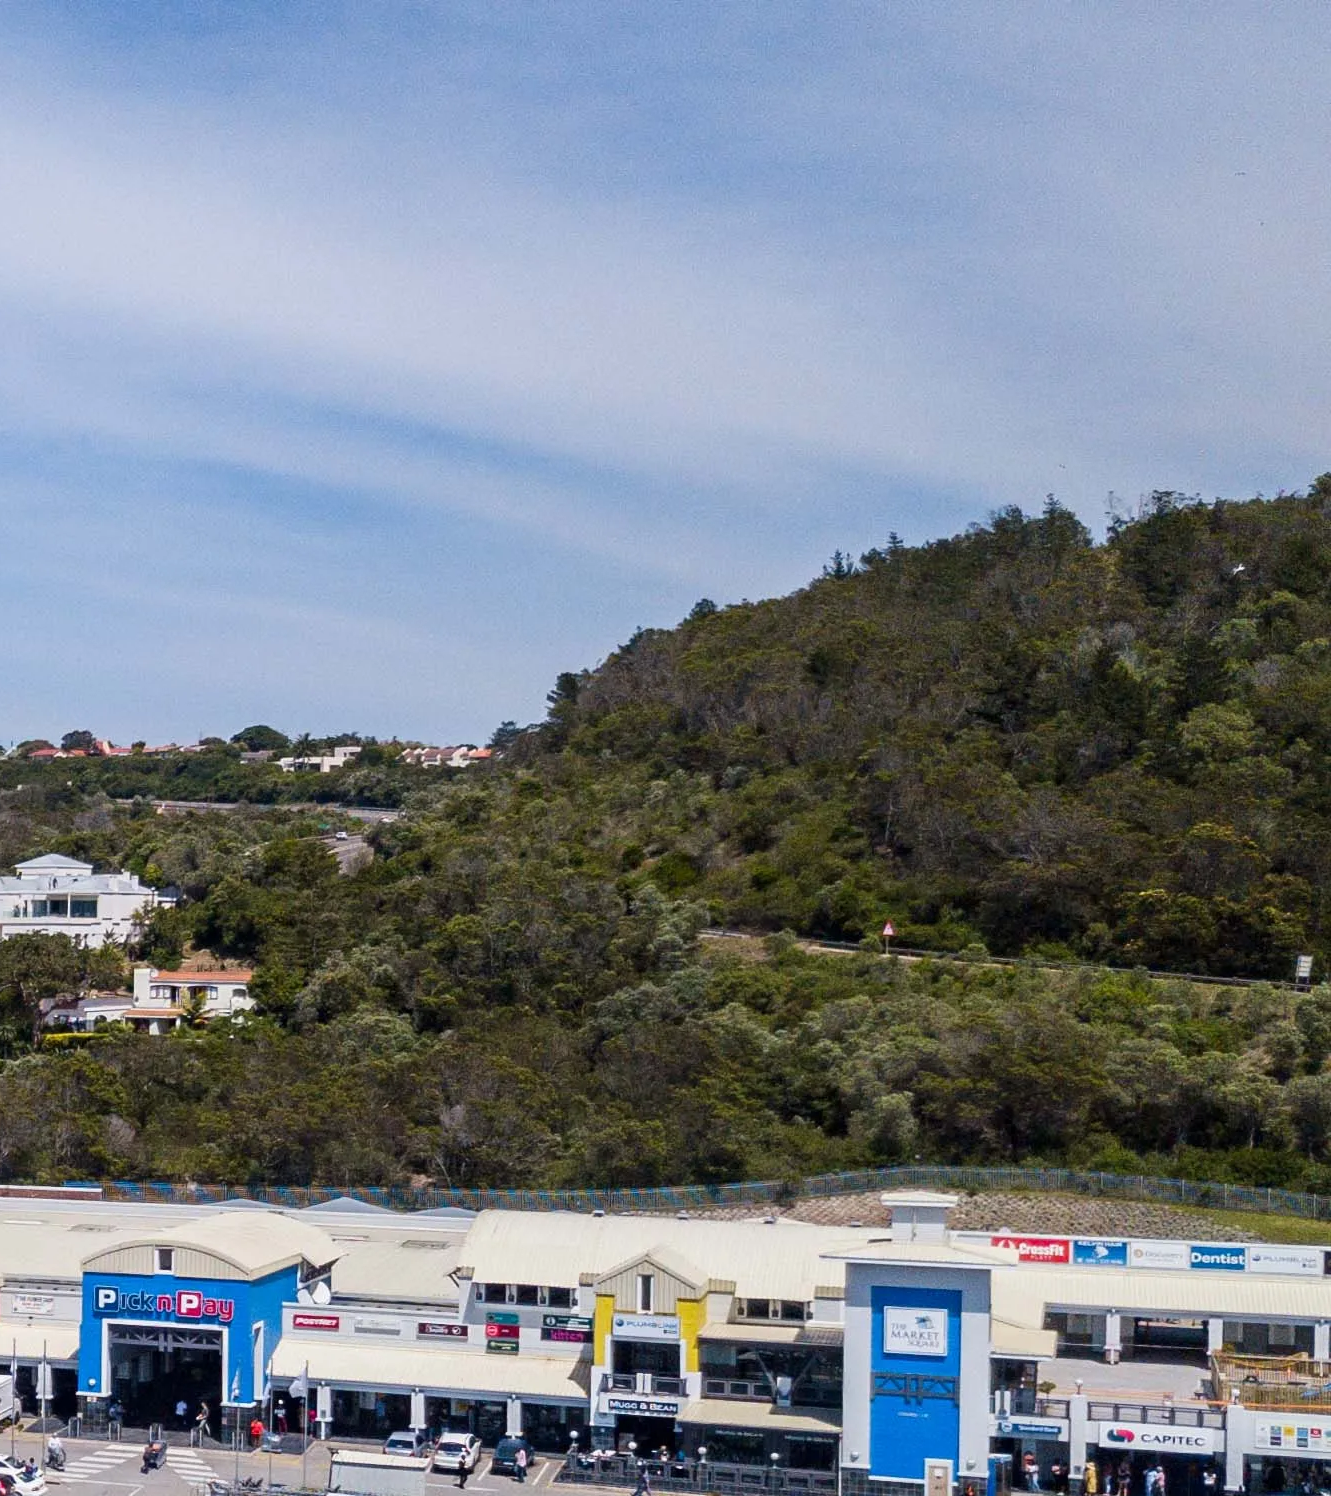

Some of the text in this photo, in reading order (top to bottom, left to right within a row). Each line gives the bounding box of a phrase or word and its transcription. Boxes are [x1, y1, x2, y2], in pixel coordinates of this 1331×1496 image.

[1019, 1242, 1064, 1257] CrossFit
[1191, 1251, 1246, 1265] Dentist
[94, 1285, 234, 1321] Pick n Pay
[295, 1316, 337, 1327] POSTNET
[891, 1330, 939, 1341] MARKET
[609, 1400, 637, 1410] MUGG
[649, 1403, 677, 1412] BEAN
[1140, 1433, 1207, 1447] CAPITEC
